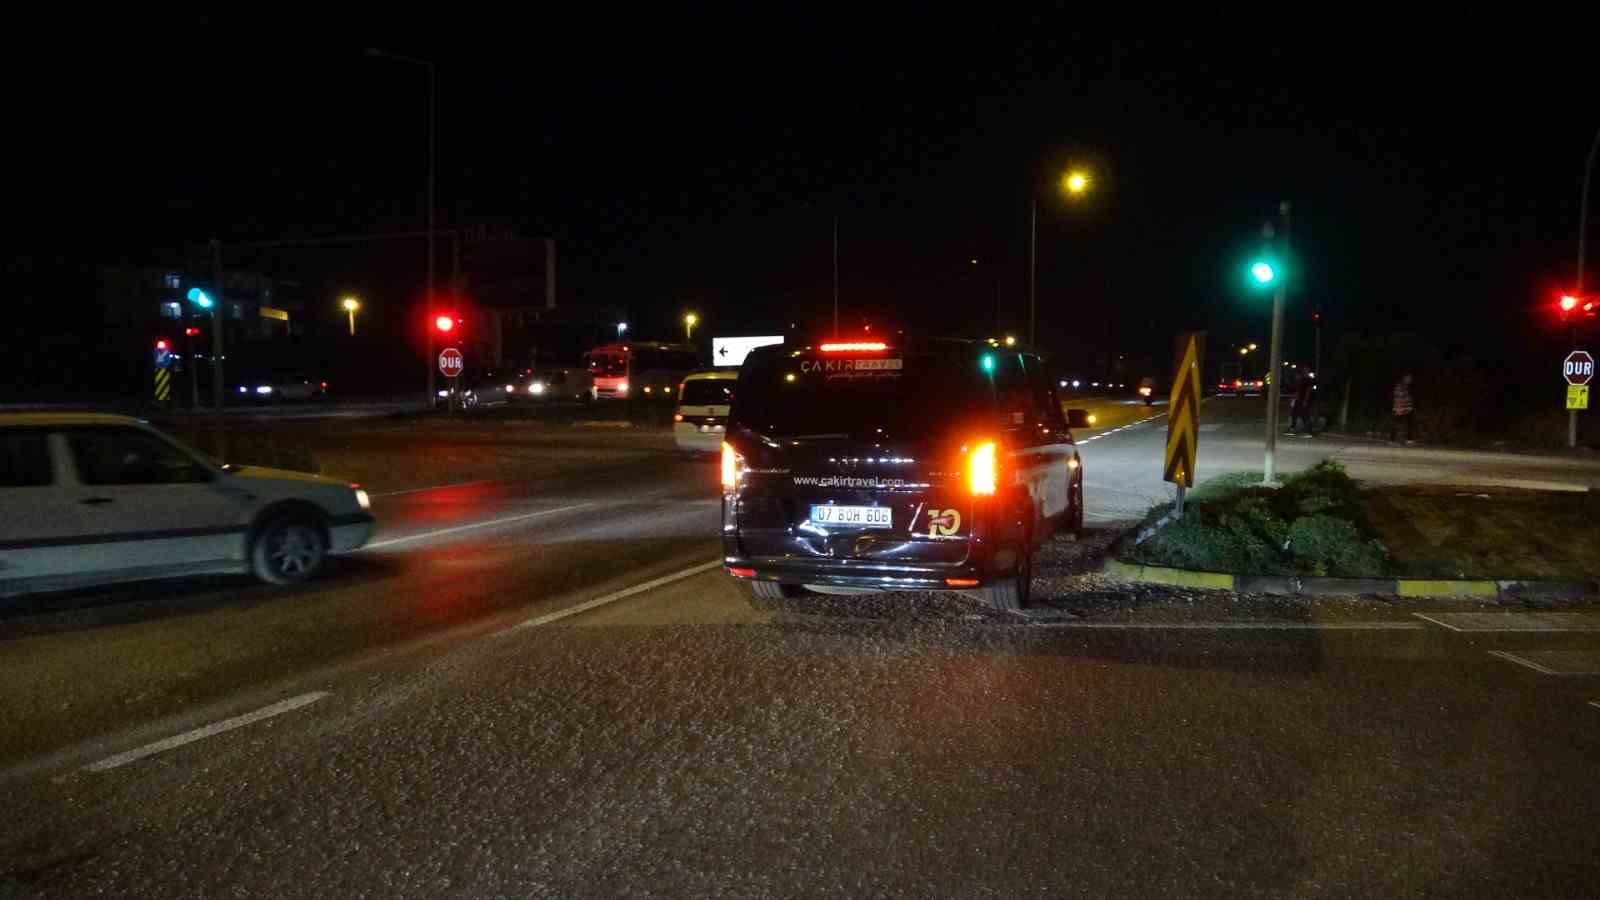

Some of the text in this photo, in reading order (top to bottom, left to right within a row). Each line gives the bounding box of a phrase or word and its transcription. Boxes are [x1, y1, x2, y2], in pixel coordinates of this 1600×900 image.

[441, 356, 462, 369] DUR
[1566, 361, 1592, 376] DUR
[818, 508, 832, 521] 07
